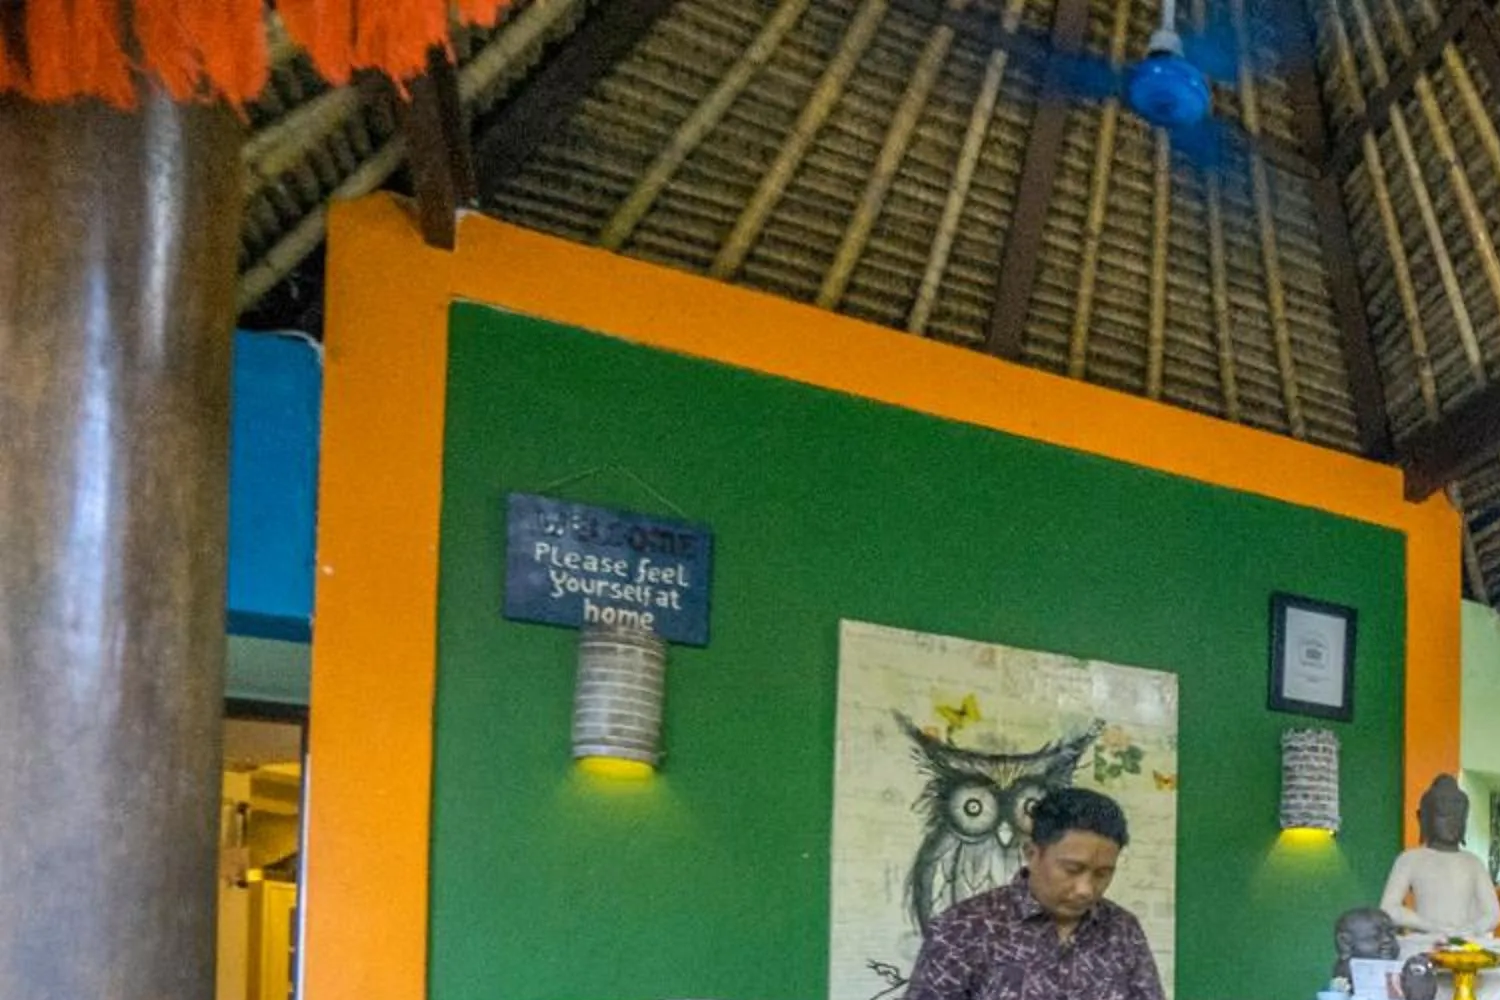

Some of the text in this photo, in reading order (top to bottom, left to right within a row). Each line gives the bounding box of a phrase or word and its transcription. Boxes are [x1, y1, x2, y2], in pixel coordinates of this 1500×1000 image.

[533, 541, 690, 588] Please feel
[583, 597, 655, 631] home
[655, 588, 682, 610] at
